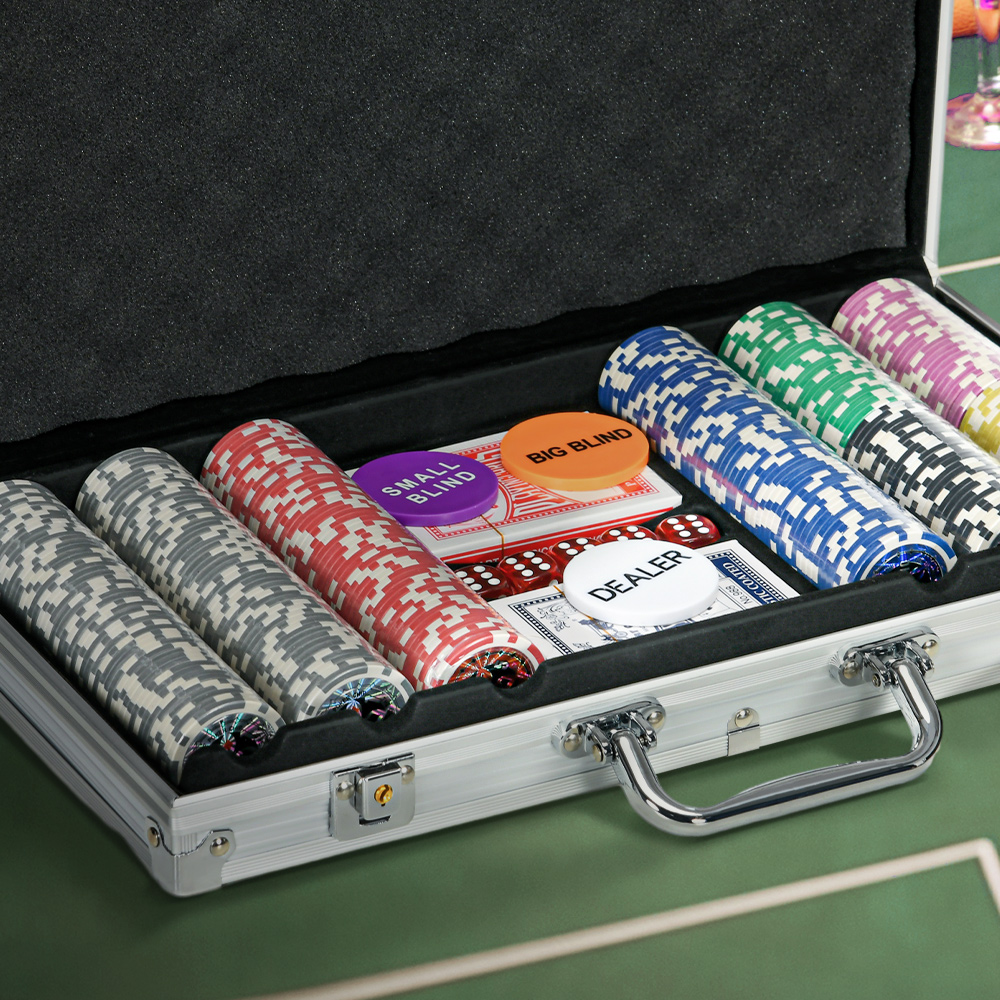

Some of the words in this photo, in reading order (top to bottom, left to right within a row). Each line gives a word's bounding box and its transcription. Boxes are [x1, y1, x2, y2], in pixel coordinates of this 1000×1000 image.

[526, 446, 568, 464] BIG
[566, 428, 633, 452] BLIND
[381, 462, 461, 497] SMALL
[405, 471, 476, 504] BLIND
[588, 550, 692, 602] DEALER
[722, 562, 759, 591] COATED
